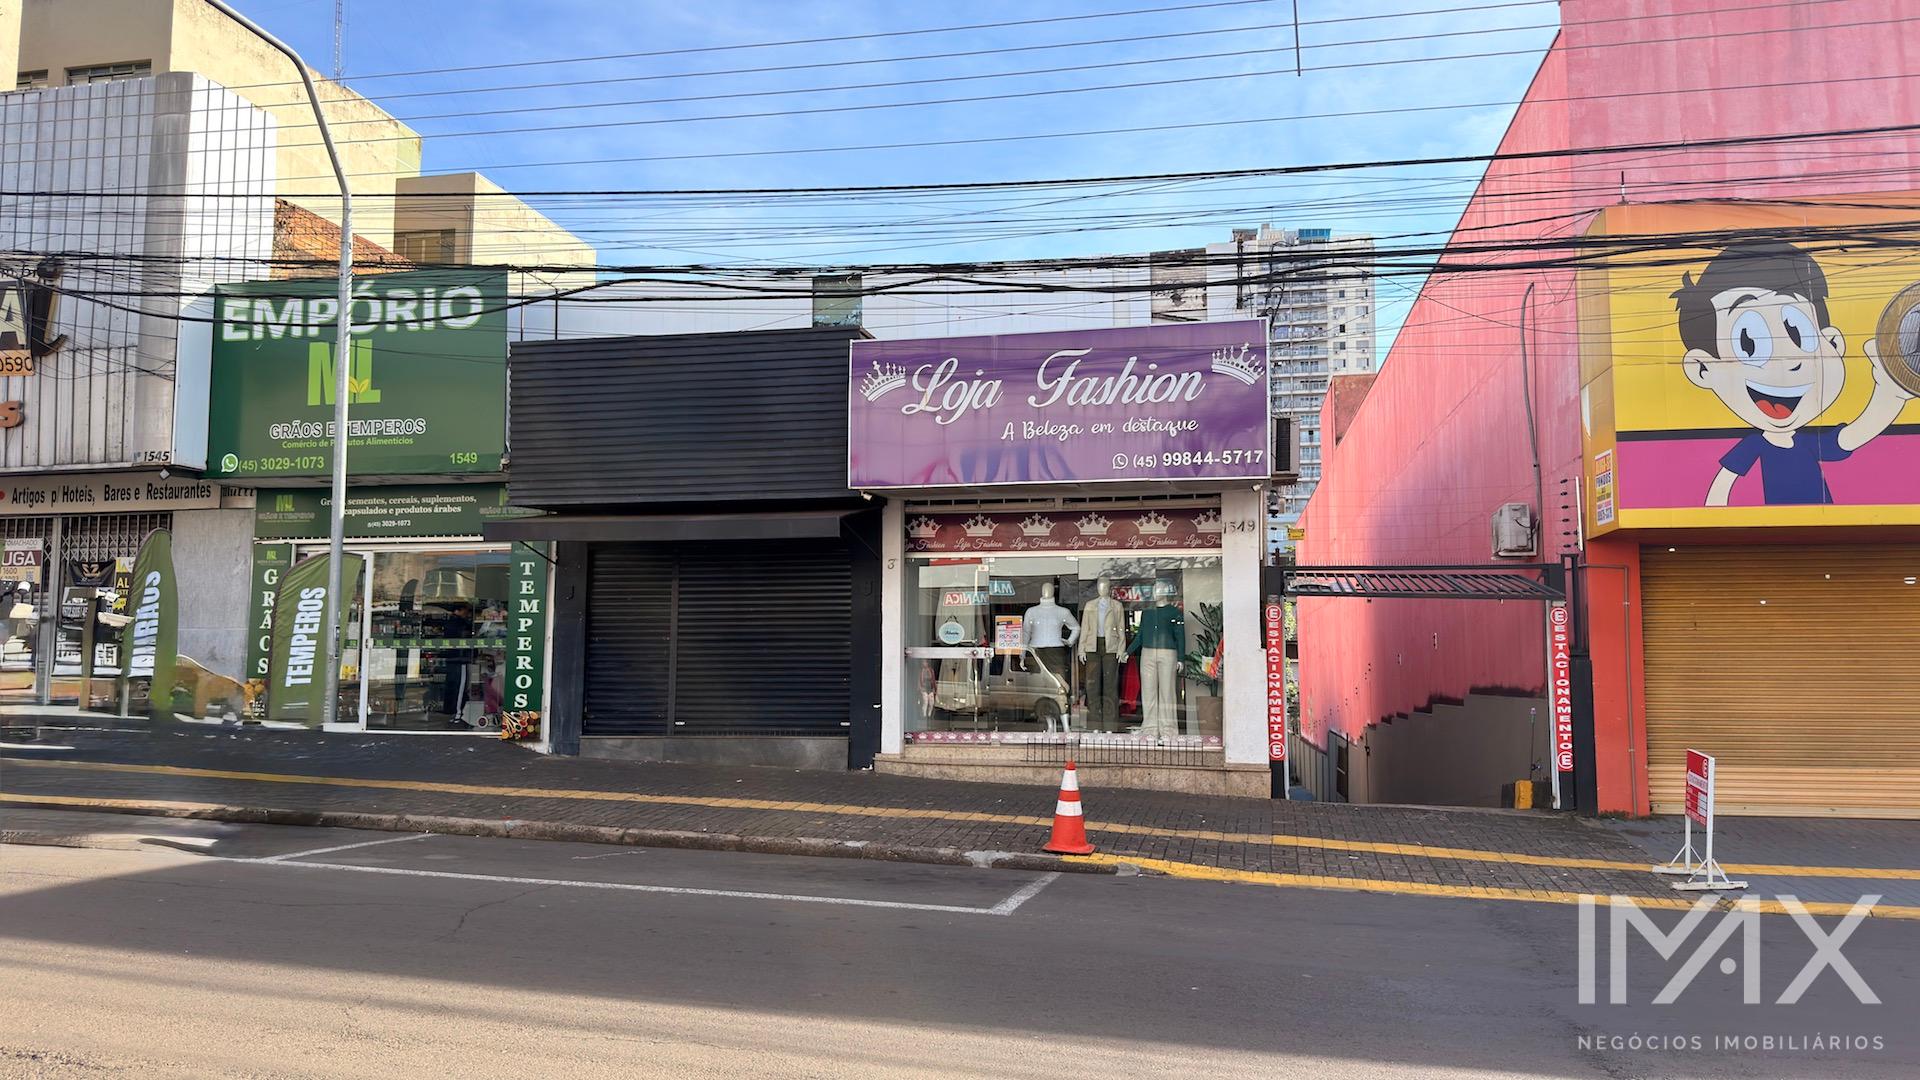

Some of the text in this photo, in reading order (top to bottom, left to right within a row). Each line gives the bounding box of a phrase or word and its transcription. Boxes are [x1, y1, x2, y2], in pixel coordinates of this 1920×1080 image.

[222, 279, 484, 341] EMPÓRIO
[901, 347, 1206, 425] Loja Fashion
[270, 420, 323, 439] GRÃOS
[347, 418, 427, 436] EMPEROS
[1001, 417, 1199, 441] A Beleza em destaque
[282, 439, 317, 449] Comércio
[143, 451, 170, 463] 1545
[238, 456, 325, 472] (45) 3029-1073
[450, 452, 478, 465] 1549
[1132, 450, 1264, 469] (45) 99844-5717
[12, 488, 45, 508] Artigos
[62, 484, 95, 505] Hoteis,
[104, 484, 132, 501] Bares
[134, 488, 140, 500] e
[146, 482, 212, 500] Restaurantes
[348, 497, 387, 505] sementes,
[389, 496, 420, 504] cereais,
[421, 495, 477, 504] suplementos,
[395, 505, 432, 515] produtos
[434, 505, 461, 513] árabes
[285, 586, 327, 688] TEMPEROS
[514, 561, 540, 709] TEMPEROS
[1268, 621, 1282, 740] ESTACIONAMENTO
[1555, 625, 1573, 749] ESTACIONAMENTO
